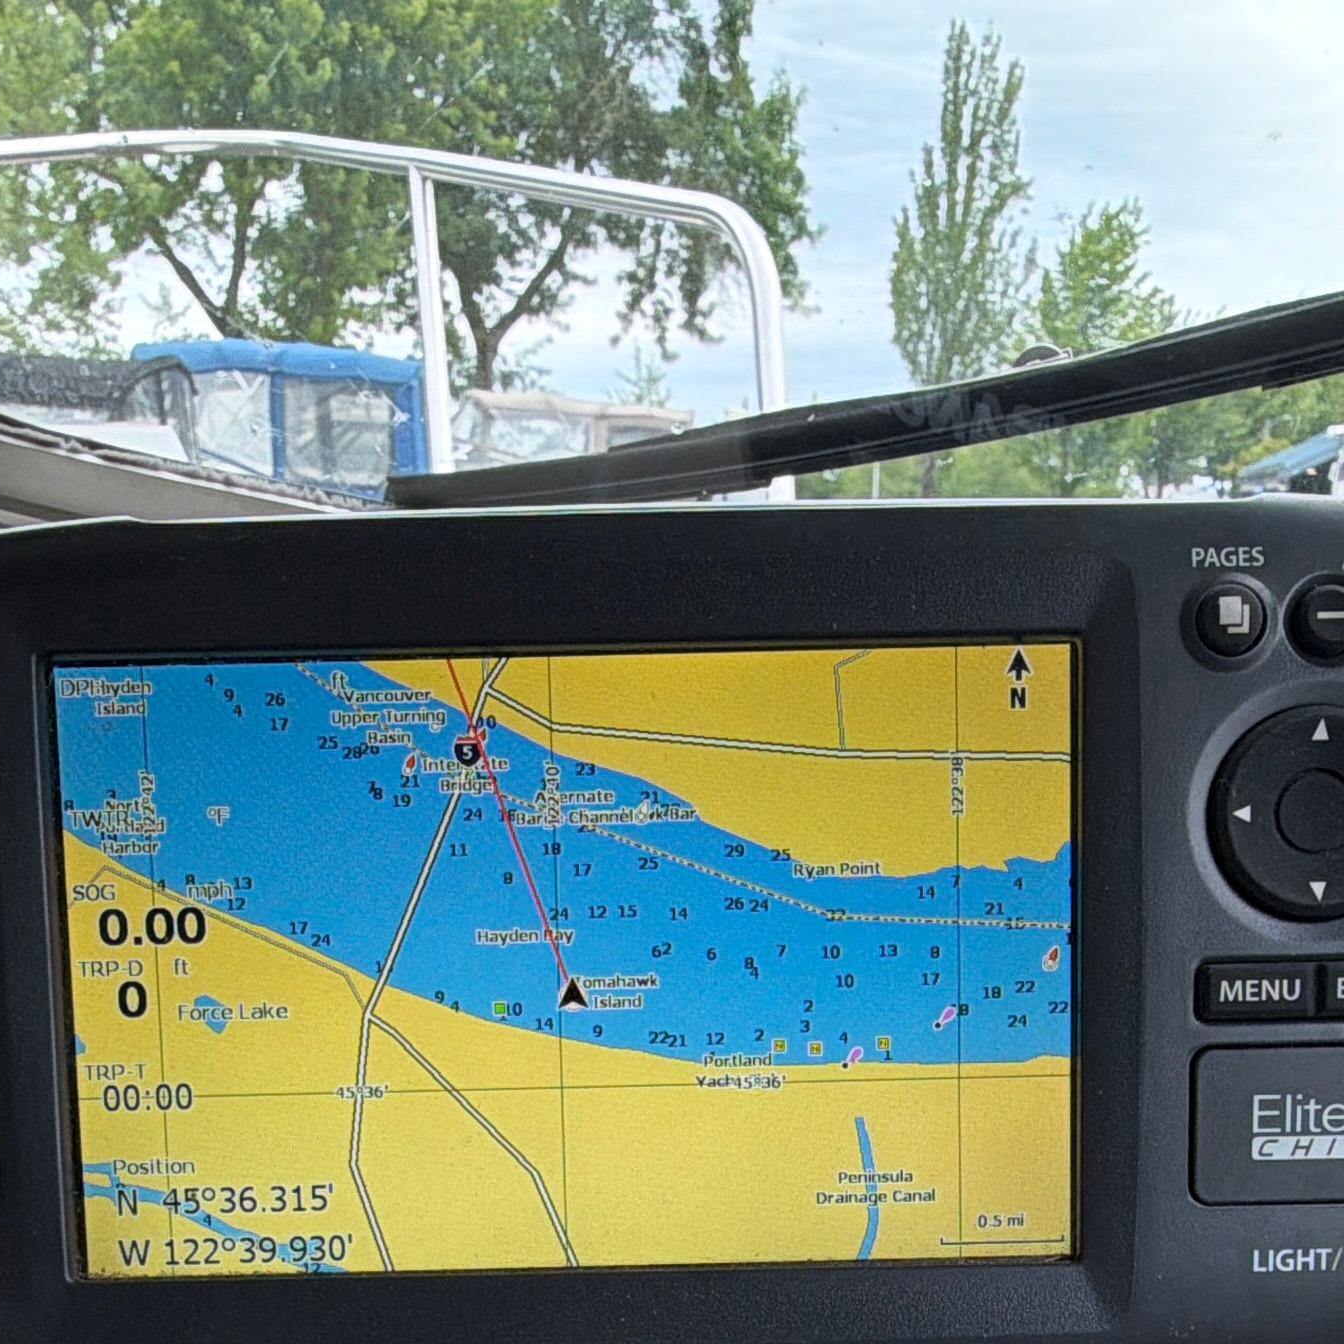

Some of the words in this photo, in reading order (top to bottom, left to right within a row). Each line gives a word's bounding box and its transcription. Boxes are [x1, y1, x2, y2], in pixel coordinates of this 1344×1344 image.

[1191, 547, 1265, 567] PAGES
[204, 673, 214, 686] 4
[332, 673, 346, 690] ft
[224, 688, 234, 701] 9
[265, 693, 285, 706] 26
[344, 691, 431, 702] Vancouver
[1011, 687, 1026, 709] N
[97, 702, 146, 715] Island
[233, 704, 242, 717] 4
[271, 718, 288, 731] 17
[332, 711, 379, 727] Upper
[386, 709, 446, 727] Turning
[317, 736, 338, 749] 25
[368, 732, 411, 744] Basin
[463, 746, 473, 760] 5
[576, 763, 595, 776] 23
[401, 775, 420, 788] 21
[440, 780, 492, 795] Bridge
[952, 751, 964, 814] 122°38'
[393, 795, 411, 807] 19
[208, 808, 229, 826] °F
[463, 809, 482, 822] 24
[569, 809, 633, 824] Channel
[670, 808, 696, 820] Bar
[103, 841, 159, 855] Harbor
[450, 844, 468, 857] 11
[543, 843, 561, 856] 18
[725, 845, 744, 858] 29
[771, 849, 790, 862] 25
[638, 857, 658, 870] 25
[573, 864, 592, 877] 17
[794, 864, 836, 880] Ryan
[841, 861, 881, 875] Point
[234, 877, 252, 890] 13
[951, 875, 960, 888] 7
[1014, 877, 1023, 890] 4
[73, 884, 116, 901] SOG
[188, 882, 234, 900] mph
[918, 886, 935, 899] 14
[227, 899, 245, 911] 12
[724, 897, 744, 910] 26
[749, 900, 769, 913] 24
[985, 903, 1004, 915] 21
[549, 908, 569, 920] 24
[588, 906, 607, 919] 12
[619, 905, 637, 918] 15
[669, 908, 688, 920] 14
[99, 907, 206, 945] 0.00
[290, 922, 308, 935] 17
[311, 934, 331, 947] 24
[477, 930, 538, 946] Hayden
[707, 948, 717, 961] 6
[777, 945, 786, 958] 7
[822, 946, 841, 959] 10
[879, 945, 897, 958] 13
[78, 960, 143, 977] TRP-D
[173, 959, 189, 976] ft
[575, 975, 658, 988] Tomahawk
[836, 974, 854, 988] 10
[922, 973, 940, 986] 17
[983, 986, 1002, 999] 18
[1015, 981, 1035, 994] 22
[1219, 979, 1301, 1002] MENU
[118, 981, 148, 1018] 0
[435, 991, 444, 1003] 9
[594, 995, 642, 1008] Island
[179, 1005, 233, 1021] Force
[240, 1002, 288, 1019] Lake
[804, 1000, 814, 1012] 2
[1049, 1001, 1068, 1014] 22
[536, 1018, 554, 1031] 14
[800, 1020, 810, 1033] 3
[1008, 1015, 1027, 1028] 24
[593, 1025, 603, 1038] 9
[649, 1031, 668, 1044] 22
[755, 1029, 764, 1042] 2
[839, 1032, 848, 1044] 4
[668, 1035, 686, 1048] 21
[706, 1033, 724, 1046] 12
[704, 1053, 772, 1068] Portland
[84, 1064, 146, 1081] TRP-T
[103, 1084, 193, 1112] 00:00
[113, 1160, 195, 1175] Position
[838, 1170, 913, 1184] Peninsula
[118, 1189, 138, 1215] N
[163, 1183, 333, 1214] 45°36.315'
[816, 1191, 887, 1207] Drainage
[892, 1189, 936, 1203] Canal
[203, 1215, 212, 1226] 4
[978, 1215, 1002, 1229] 0.5
[1008, 1213, 1024, 1227] mi
[118, 1239, 150, 1267] W
[165, 1233, 353, 1266] 122°39.930'
[1252, 1247, 1343, 1273] LIGHT/
